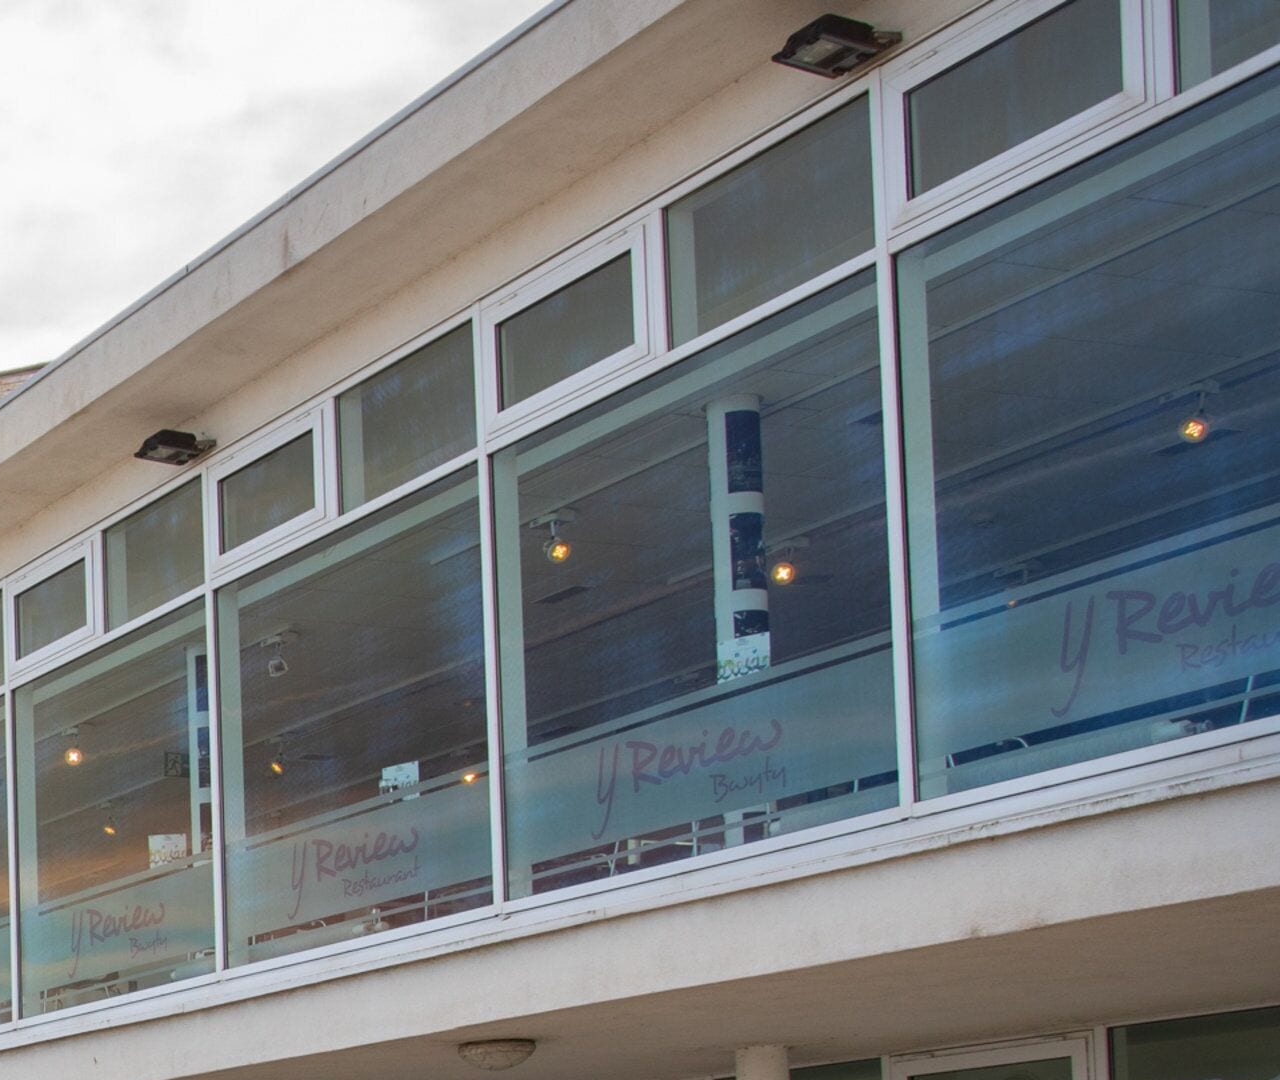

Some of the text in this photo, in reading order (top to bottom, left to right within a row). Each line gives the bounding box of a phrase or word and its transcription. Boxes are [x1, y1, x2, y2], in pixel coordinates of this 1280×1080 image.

[1106, 562, 1280, 656] Revie
[1175, 623, 1280, 672] Restau
[626, 719, 783, 793] Review
[710, 756, 786, 804] Bwyty
[312, 827, 419, 883] Review
[342, 855, 422, 898] Restaurant
[87, 903, 166, 947] Review
